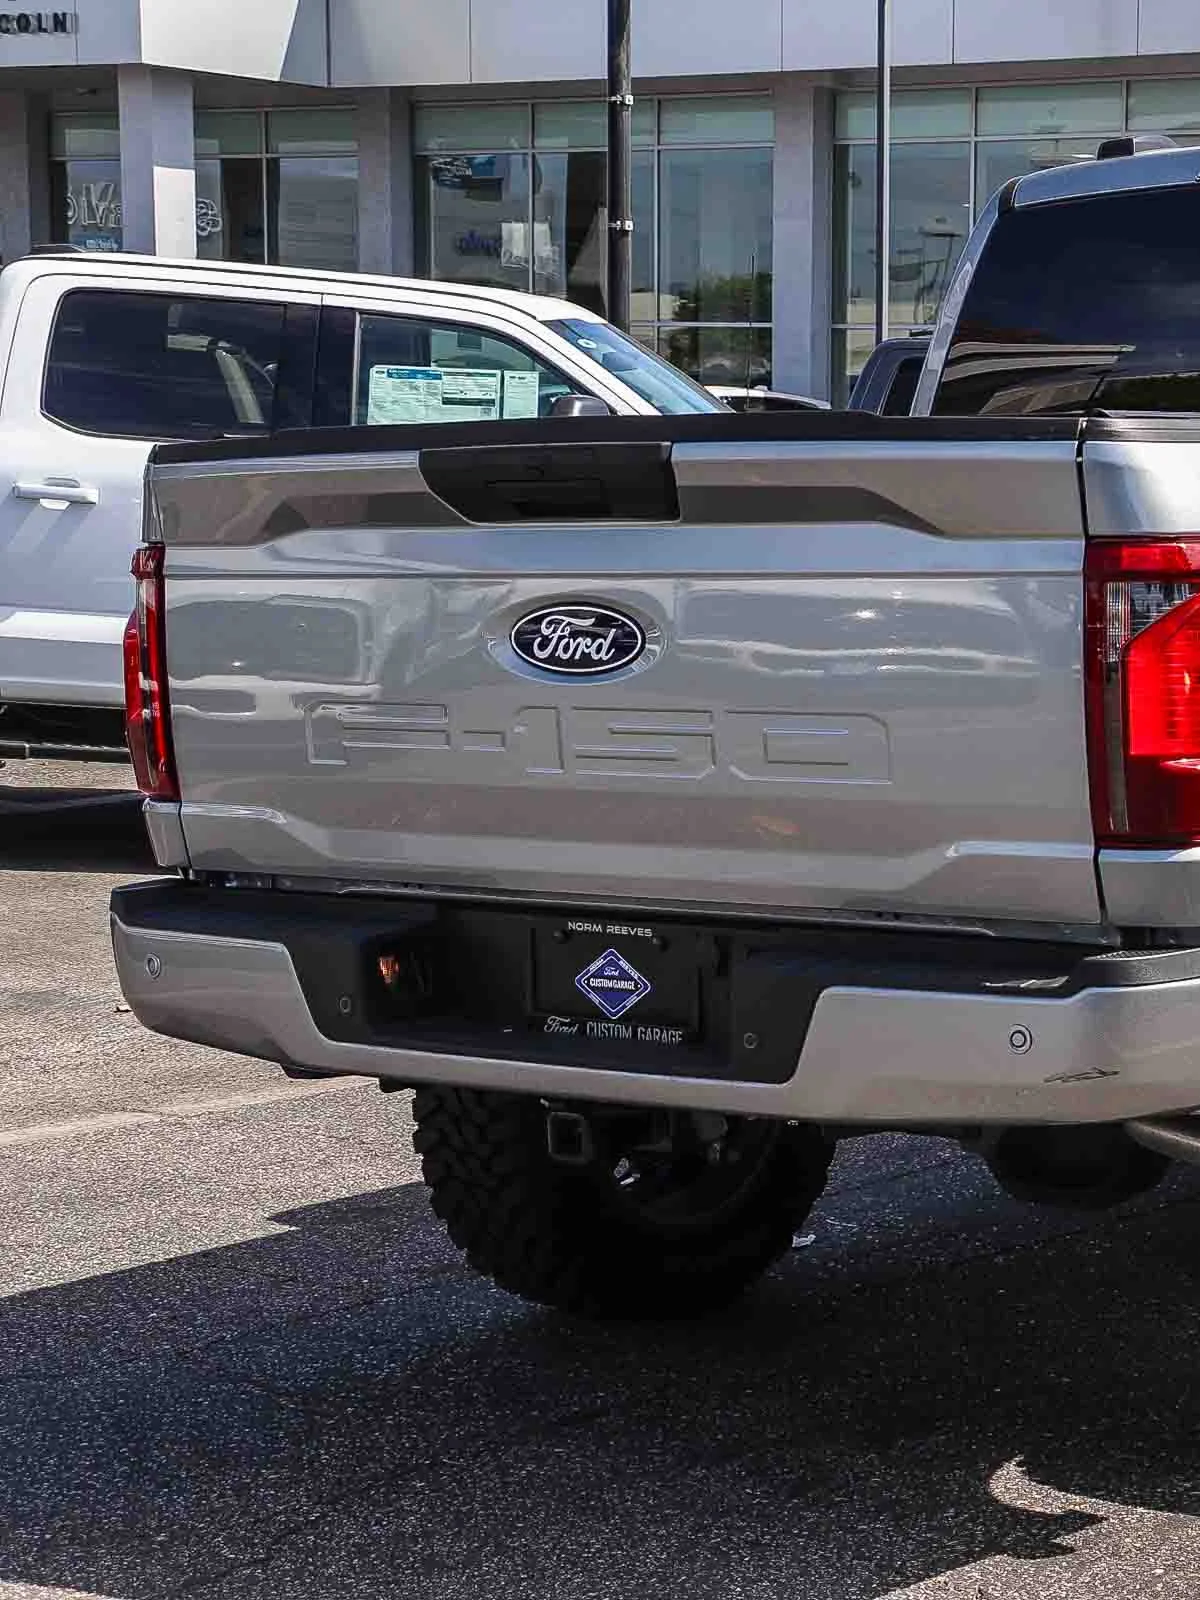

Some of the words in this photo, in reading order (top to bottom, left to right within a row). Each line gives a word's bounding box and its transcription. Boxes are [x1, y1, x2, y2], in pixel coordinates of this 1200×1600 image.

[532, 614, 618, 662] Ford
[303, 700, 893, 785] F-150
[567, 920, 603, 933] NORM
[606, 924, 653, 937] REEVES
[543, 1015, 579, 1033] Ford
[586, 1021, 632, 1041] CUSTOM
[637, 1026, 683, 1046] GARAGE
